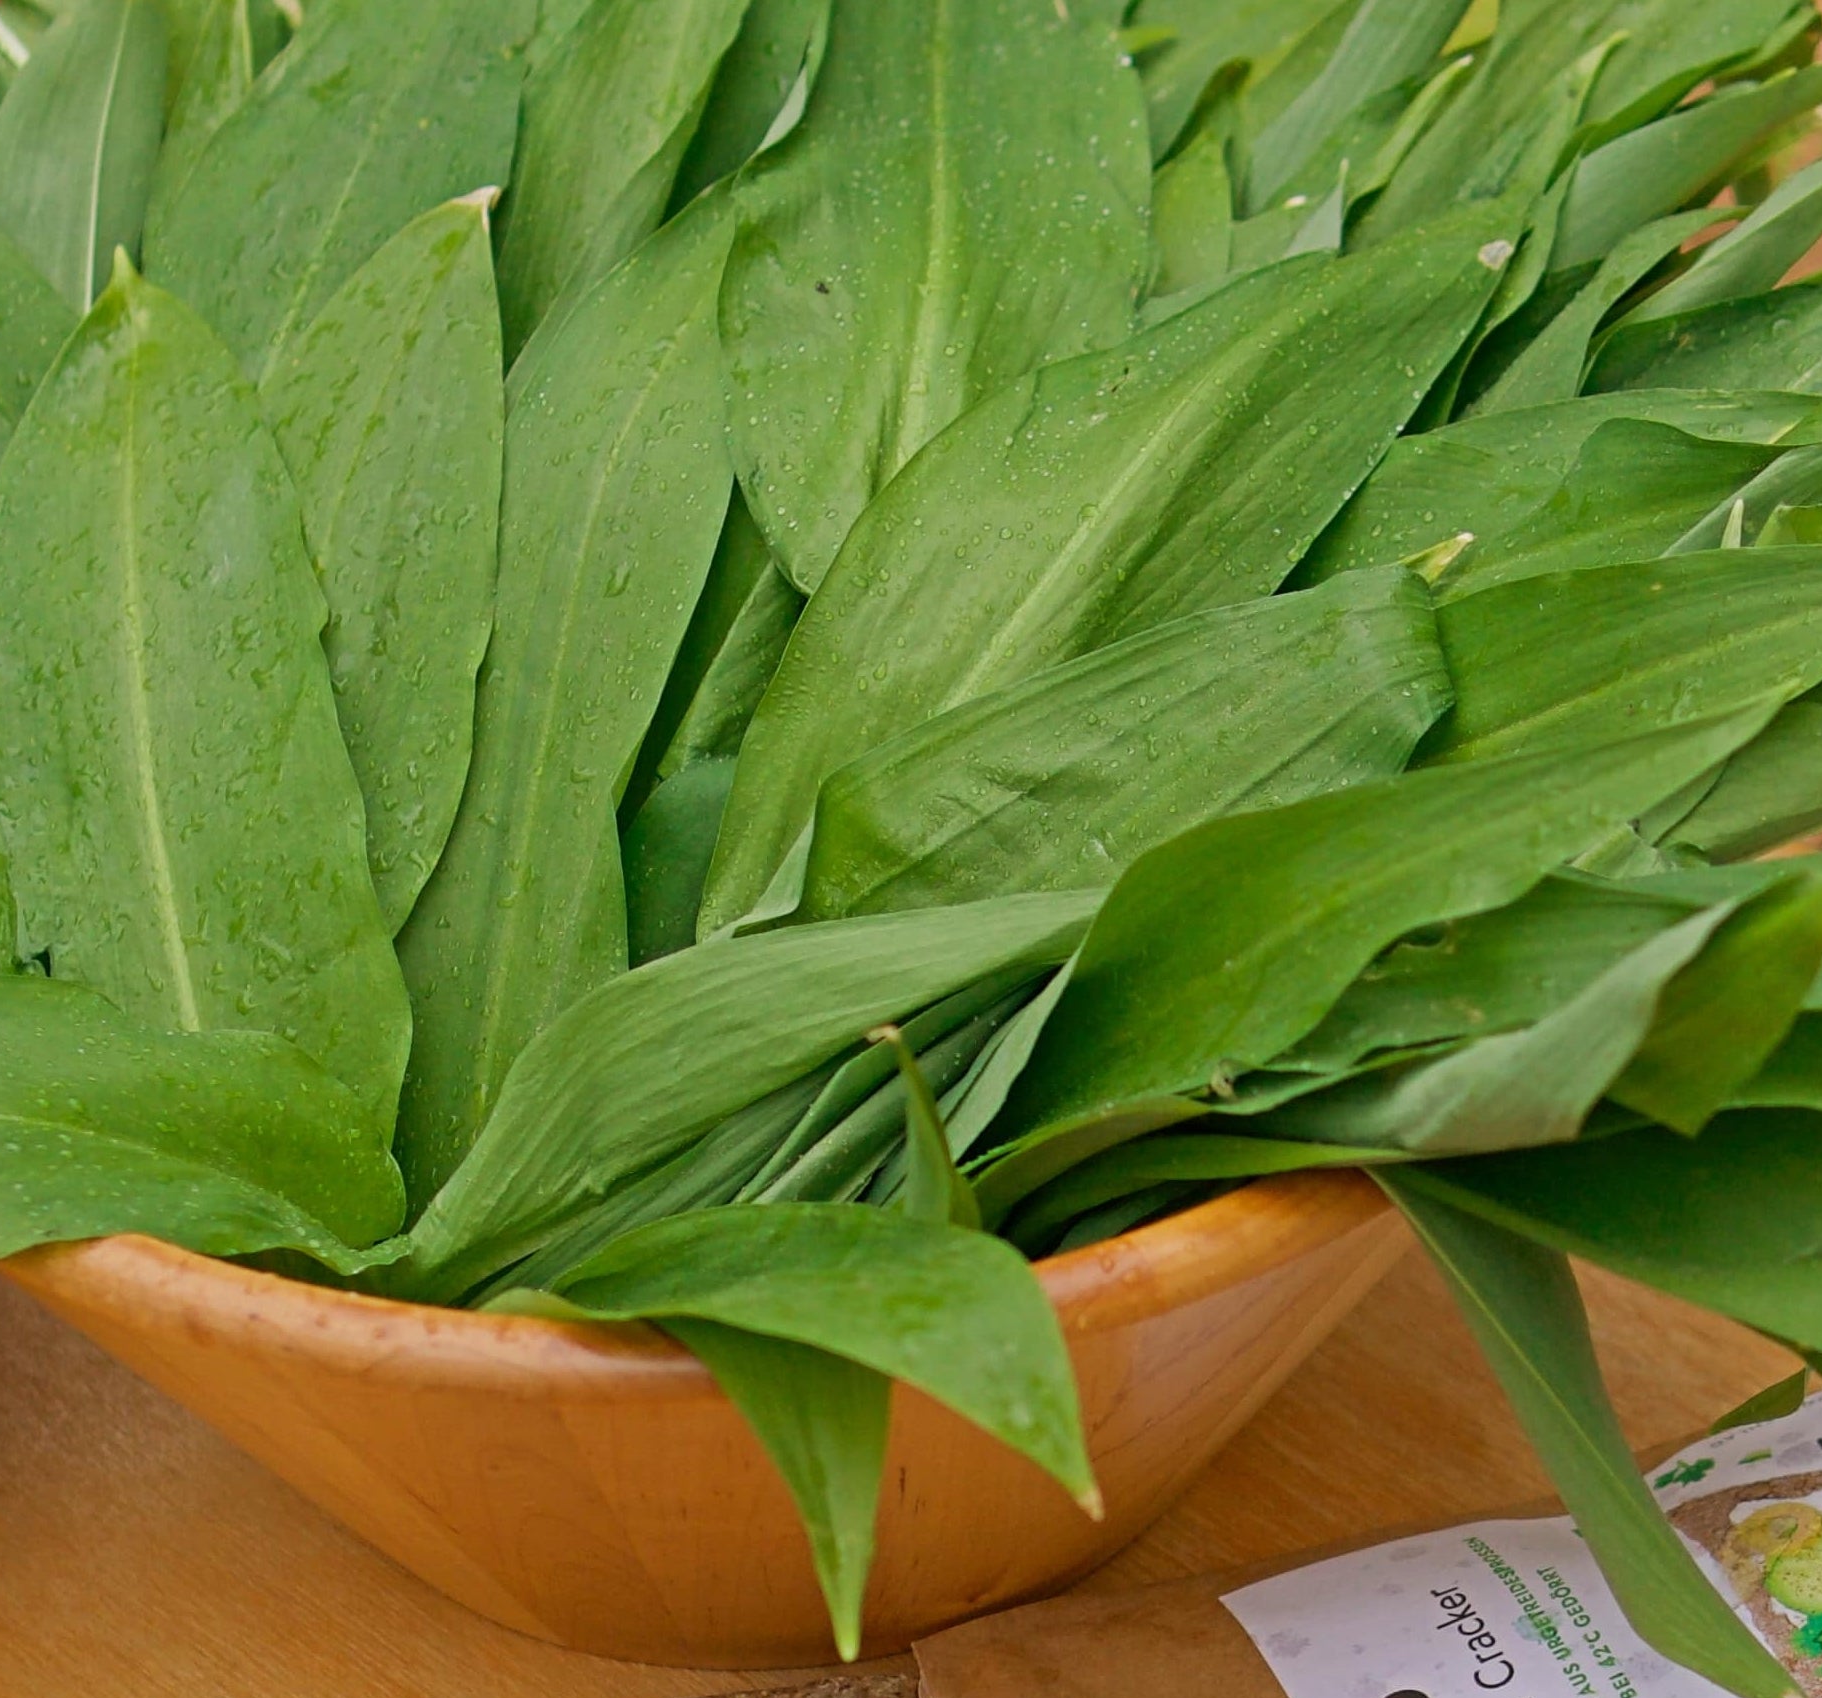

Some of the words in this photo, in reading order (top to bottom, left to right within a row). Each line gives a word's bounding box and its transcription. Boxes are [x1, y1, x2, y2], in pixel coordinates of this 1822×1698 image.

[1463, 1537, 1574, 1660] URGETREIDESPROSSEN
[1536, 1566, 1591, 1628] GEDÖRRT
[1431, 1587, 1514, 1689] Cracker
[1583, 1630, 1616, 1669] 42°C
[1563, 1662, 1597, 1696] AUS
